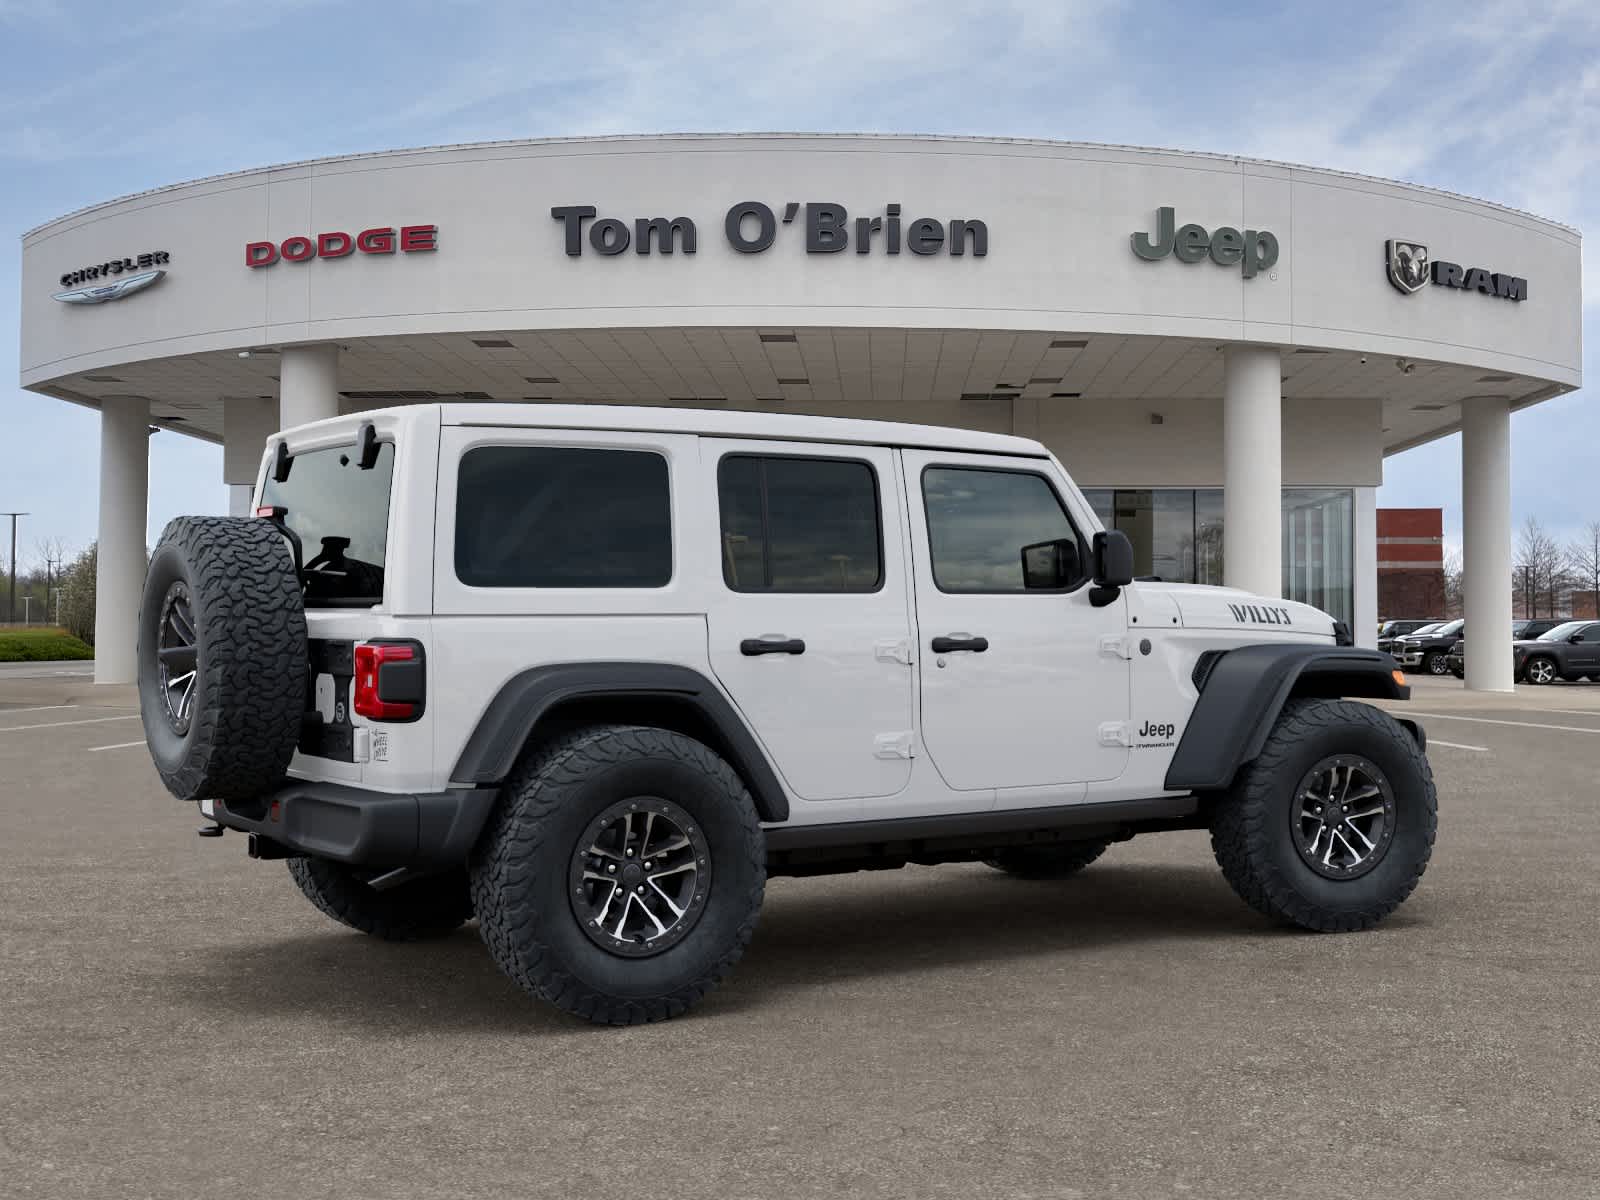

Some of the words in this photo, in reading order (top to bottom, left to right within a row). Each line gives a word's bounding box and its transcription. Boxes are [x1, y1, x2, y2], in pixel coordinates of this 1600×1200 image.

[246, 224, 438, 269] DODGE
[551, 204, 696, 256] Tom
[725, 200, 988, 257] O'Brien
[1130, 206, 1279, 279] Jeep
[60, 250, 170, 287] CHRYSLER
[1431, 260, 1528, 301] RAM
[1139, 720, 1175, 740] Jeep
